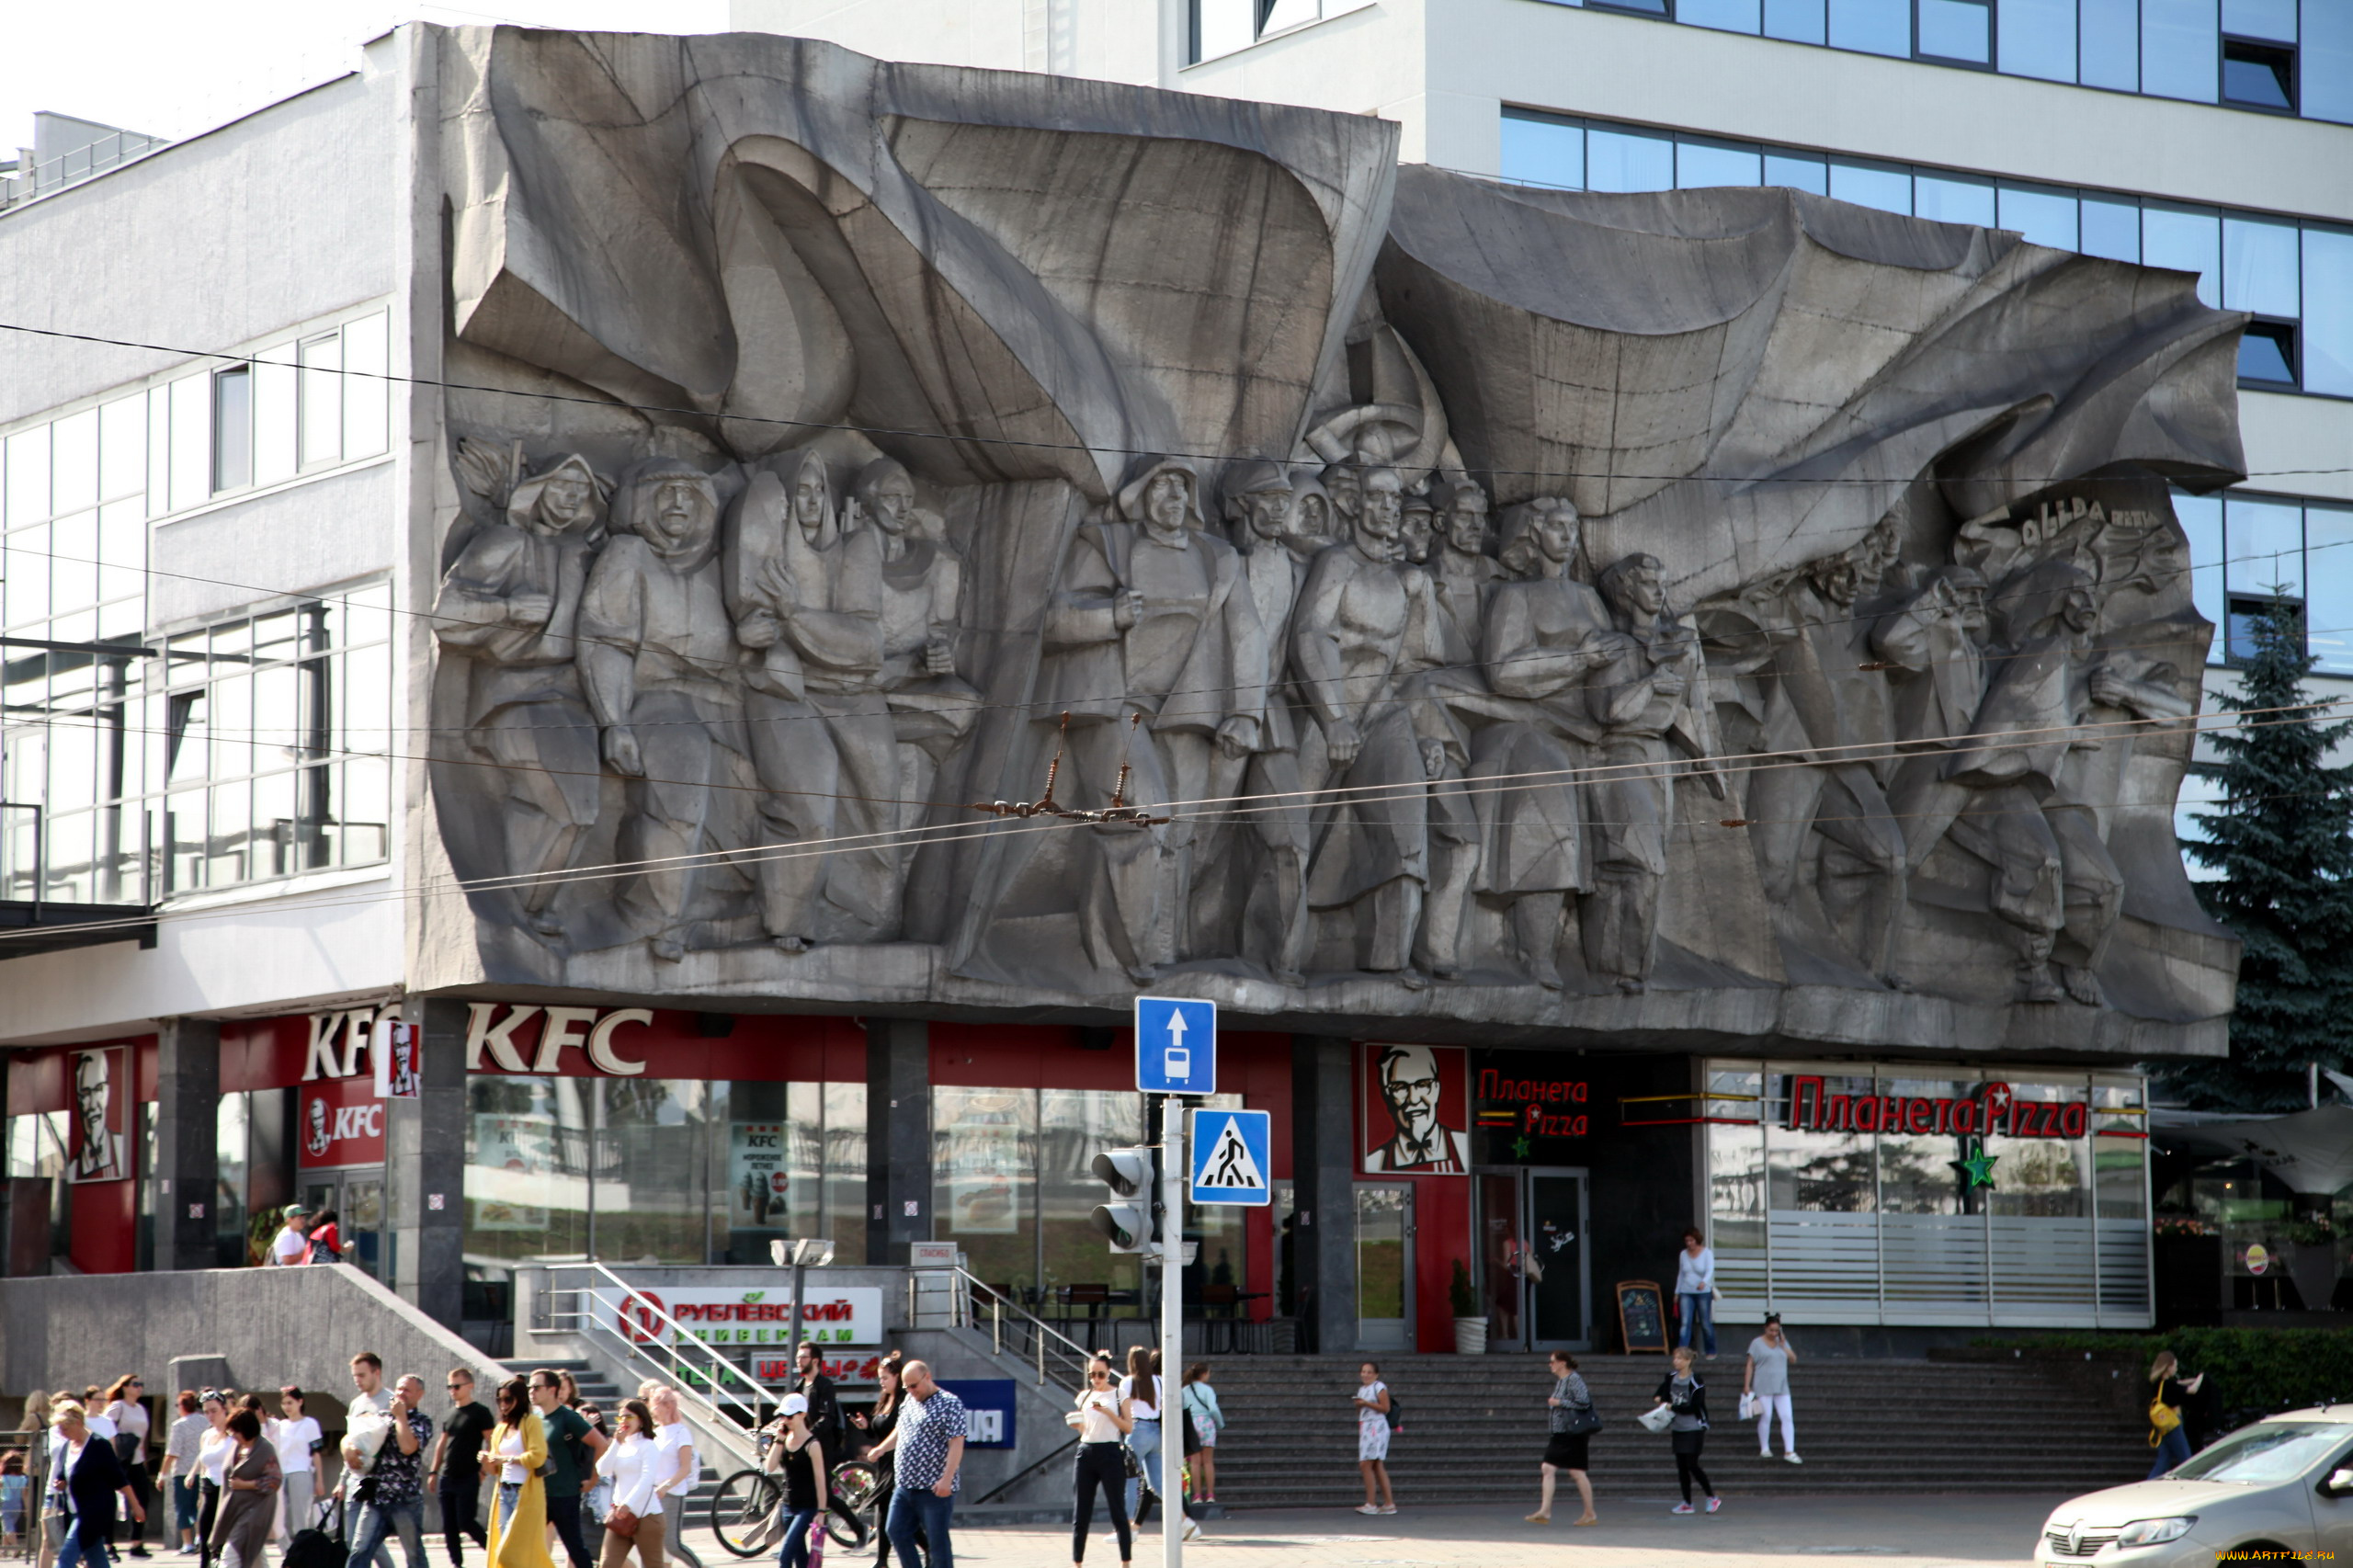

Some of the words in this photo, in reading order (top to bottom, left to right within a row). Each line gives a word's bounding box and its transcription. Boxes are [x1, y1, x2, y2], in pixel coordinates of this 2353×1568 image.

[466, 1003, 654, 1075] KFC
[1478, 1068, 1588, 1103] Планета
[333, 1104, 382, 1141] KFC
[1524, 1103, 1588, 1136] Pizza
[1788, 1075, 1977, 1133] Планета
[1985, 1081, 2087, 1138] Pizza
[747, 1135, 778, 1148] KFC
